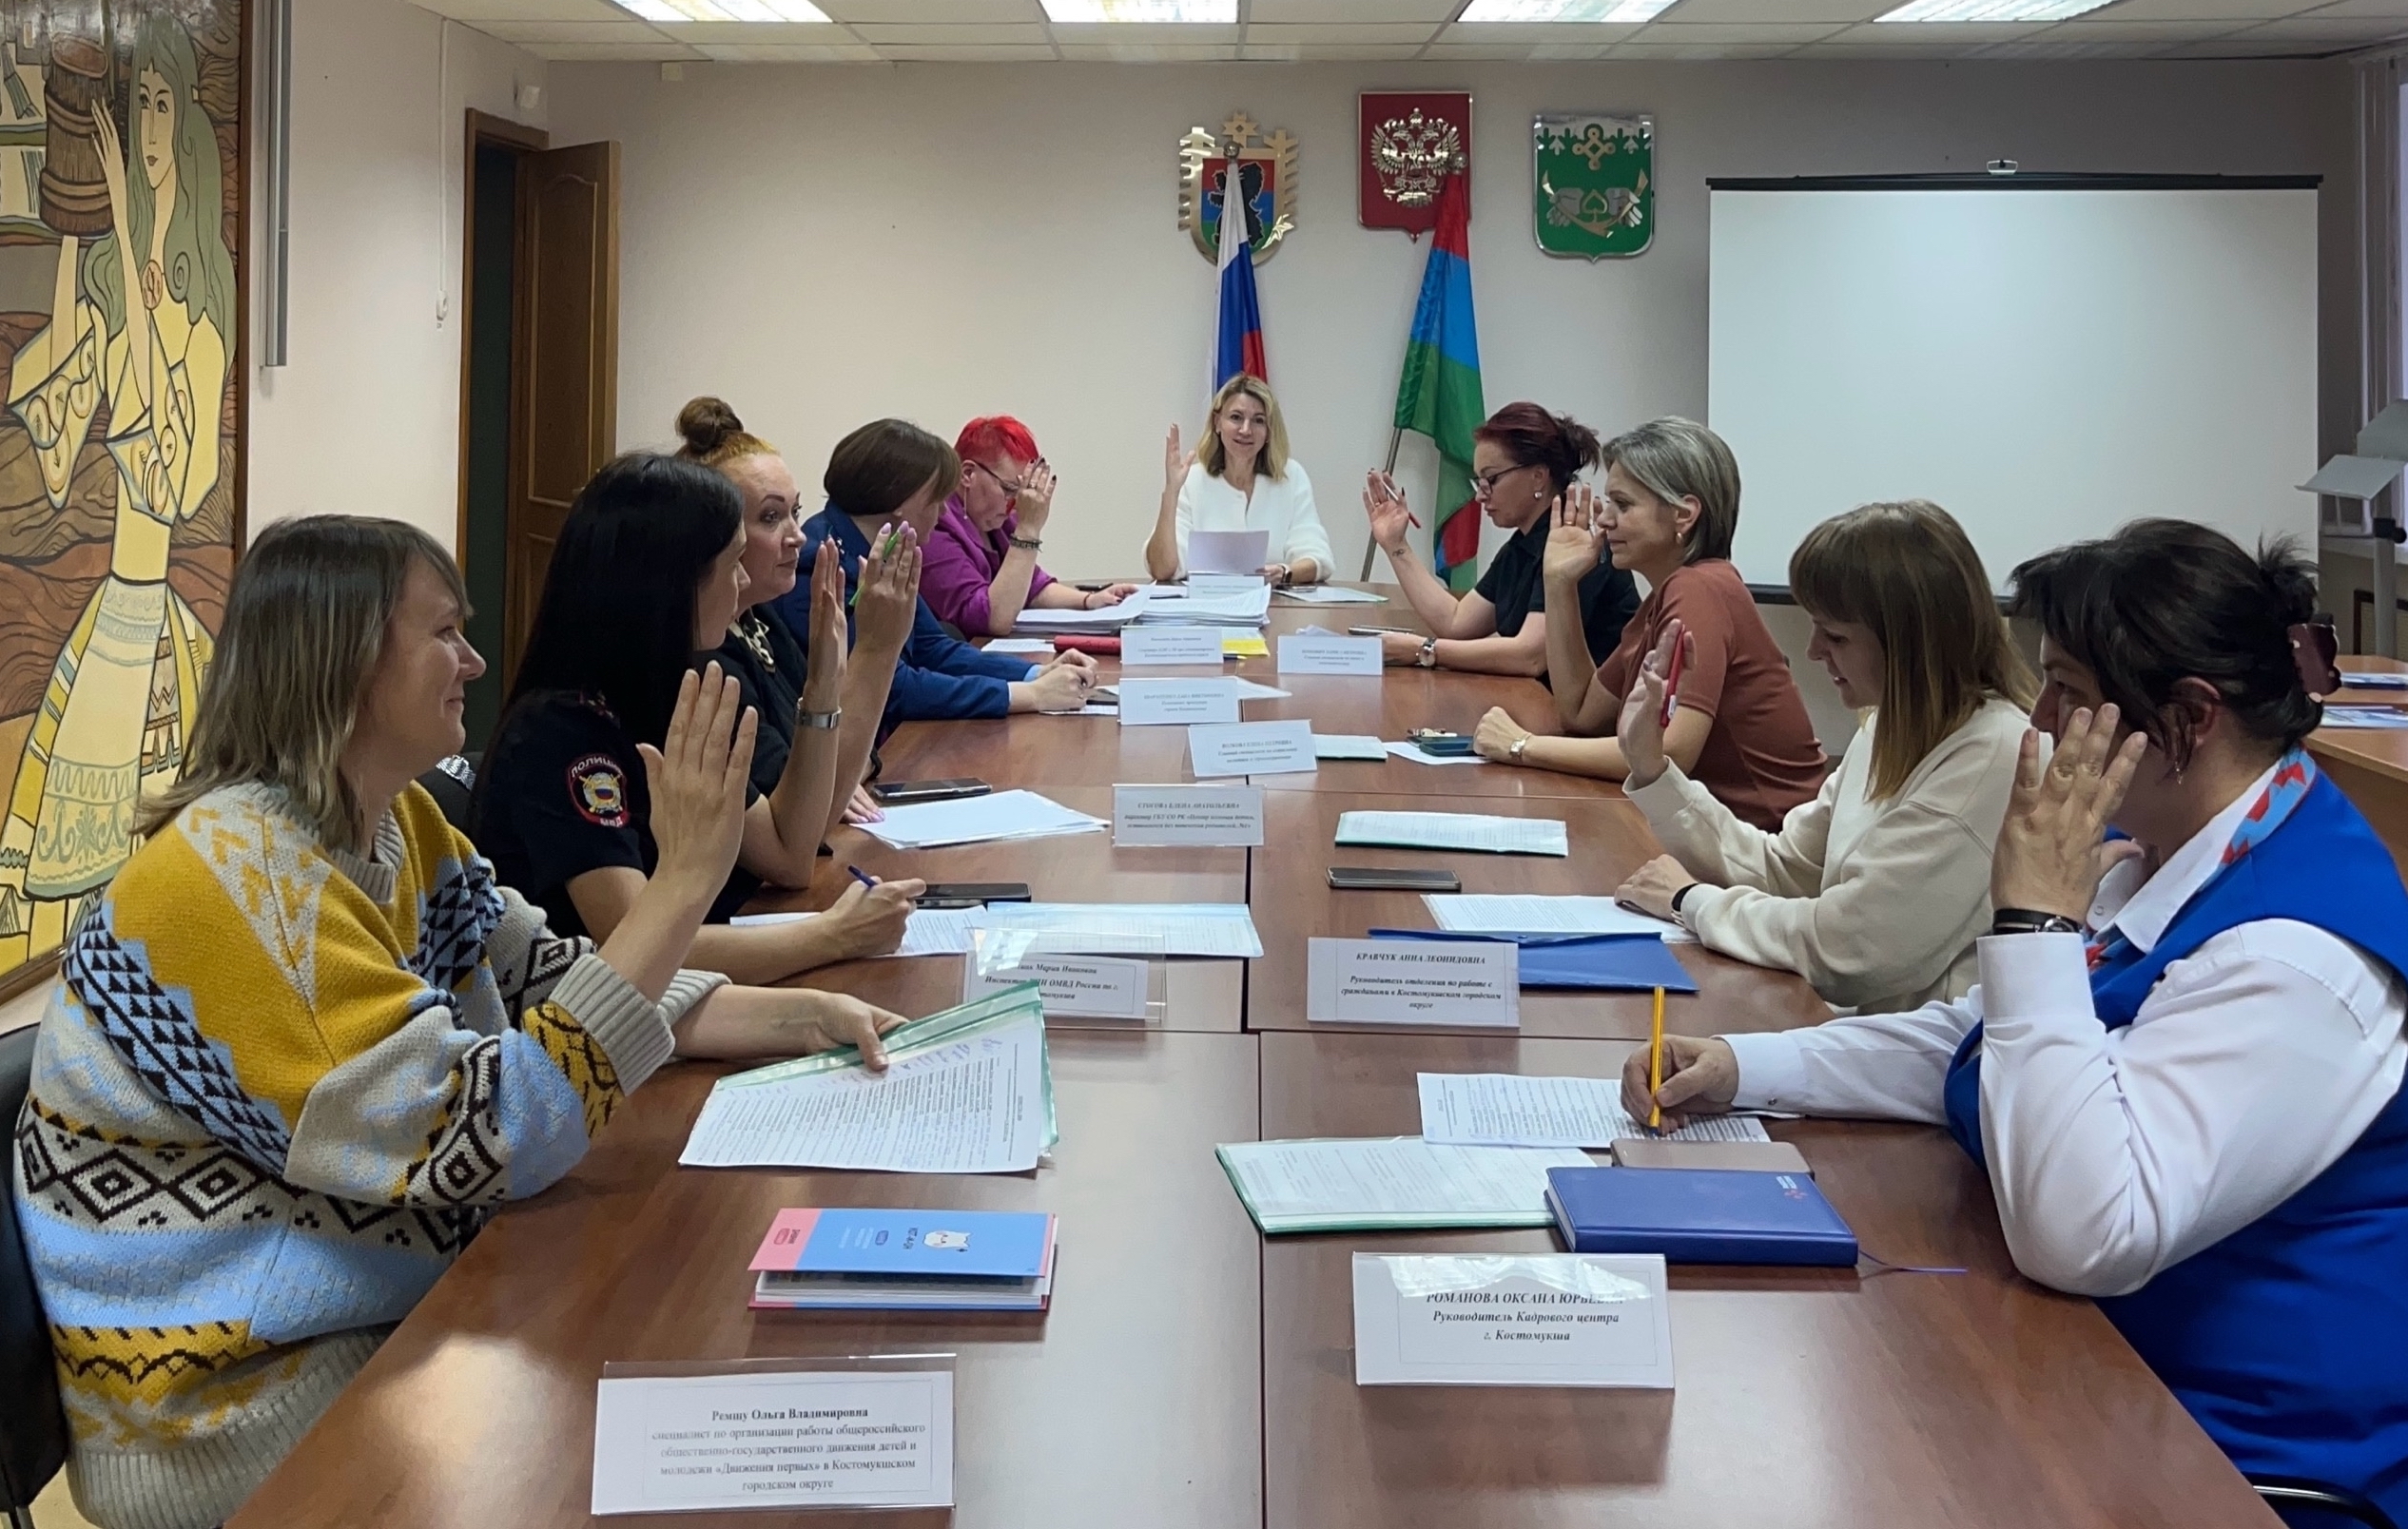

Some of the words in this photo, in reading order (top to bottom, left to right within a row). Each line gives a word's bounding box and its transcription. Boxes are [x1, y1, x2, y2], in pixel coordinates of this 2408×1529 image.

[1355, 952, 1397, 962] КРАВЧУК
[1398, 954, 1424, 963] АННА
[1424, 954, 1486, 965] ЛЕОНИДОВНА
[1426, 1292, 1500, 1304] РОМАНОВА
[1502, 1292, 1556, 1304] ОКСАНА
[1432, 1310, 1513, 1325] Руководитель
[1516, 1311, 1574, 1325] Кадрового
[1576, 1314, 1620, 1326] центра
[1483, 1331, 1491, 1342] г.
[1495, 1329, 1571, 1344] Костомукша
[711, 1409, 748, 1423] Ремшу
[751, 1409, 786, 1421] Ольга
[788, 1407, 868, 1422] Владимировна
[651, 1428, 710, 1441] специалист
[713, 1429, 727, 1439] по
[729, 1427, 793, 1442] организации
[796, 1425, 833, 1440] работы
[836, 1423, 926, 1438] общероссийского
[660, 1443, 824, 1459] общественно-государственного
[825, 1442, 876, 1454] движения
[878, 1440, 907, 1453] детей
[909, 1442, 917, 1451] и
[715, 1461, 774, 1476] «Движения
[776, 1462, 821, 1476] первых»
[824, 1461, 829, 1471] в
[831, 1458, 916, 1473] Костомукшском
[742, 1481, 797, 1494] городском
[799, 1480, 834, 1493] округе
